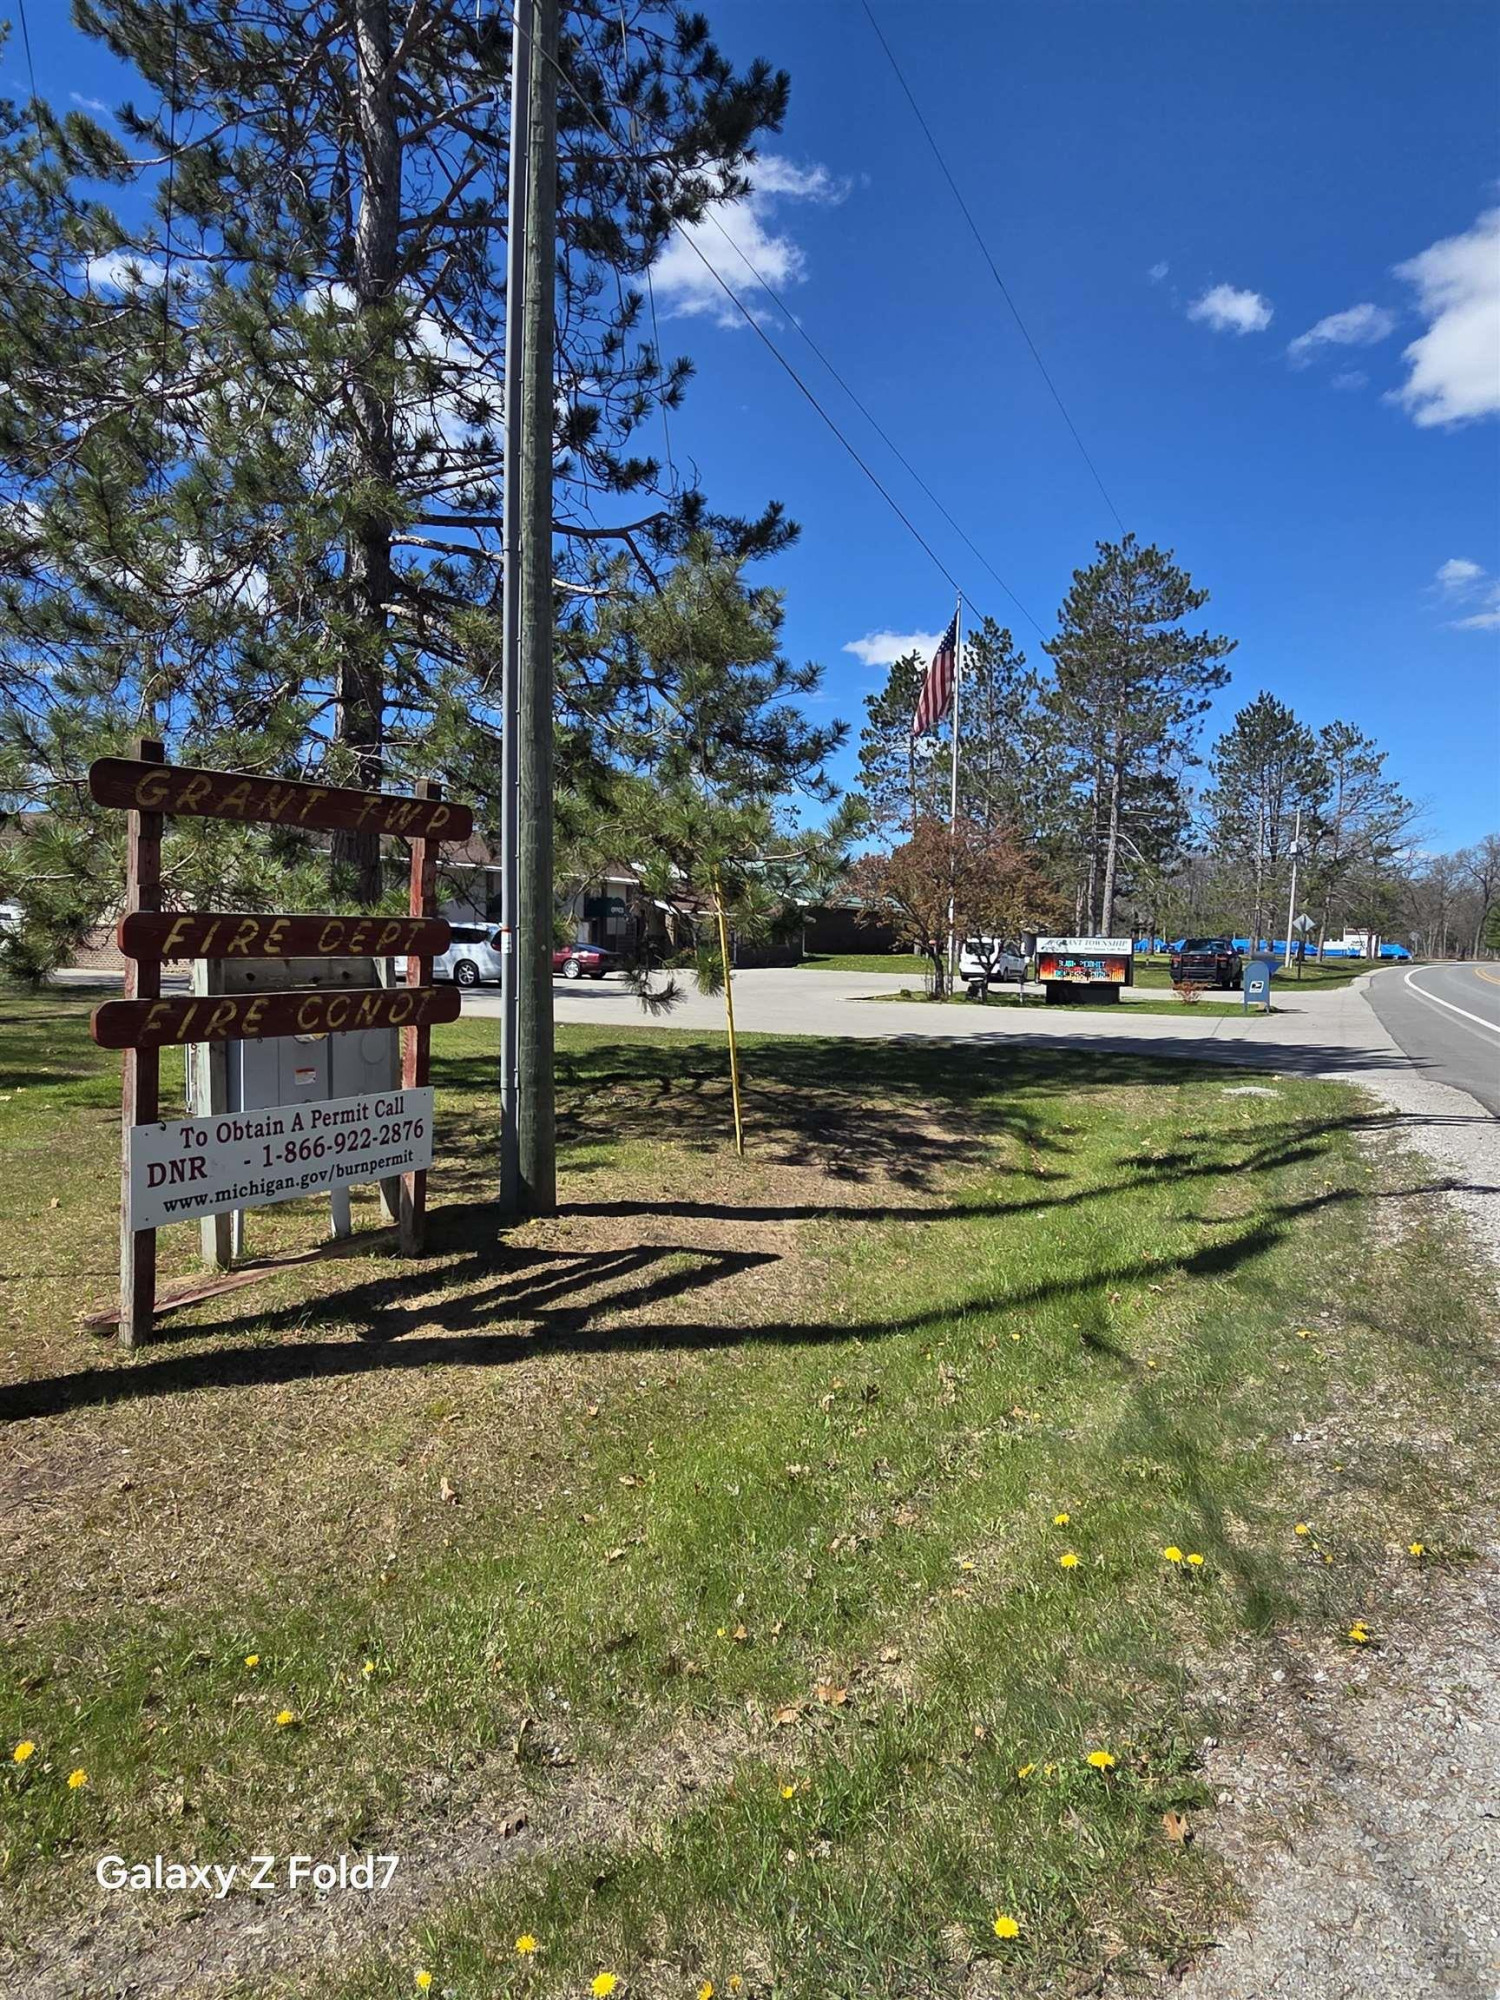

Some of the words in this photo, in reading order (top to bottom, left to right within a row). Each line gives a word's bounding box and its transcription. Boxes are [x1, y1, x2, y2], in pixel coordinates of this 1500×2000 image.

[135, 769, 328, 822] GRANT
[355, 796, 451, 834] TWP
[162, 917, 291, 955] FIRE
[317, 919, 426, 953] DEPT
[138, 999, 269, 1042] FIRE
[180, 1127, 208, 1149] To
[216, 1115, 284, 1143] Obtain
[291, 1112, 304, 1132] A
[311, 1102, 369, 1129] Permit
[374, 1096, 405, 1117] Call
[147, 1156, 208, 1188] DNR
[262, 1118, 424, 1168] 1-866-922-2876
[163, 1149, 414, 1213] www.michigan.gov/burnpermit
